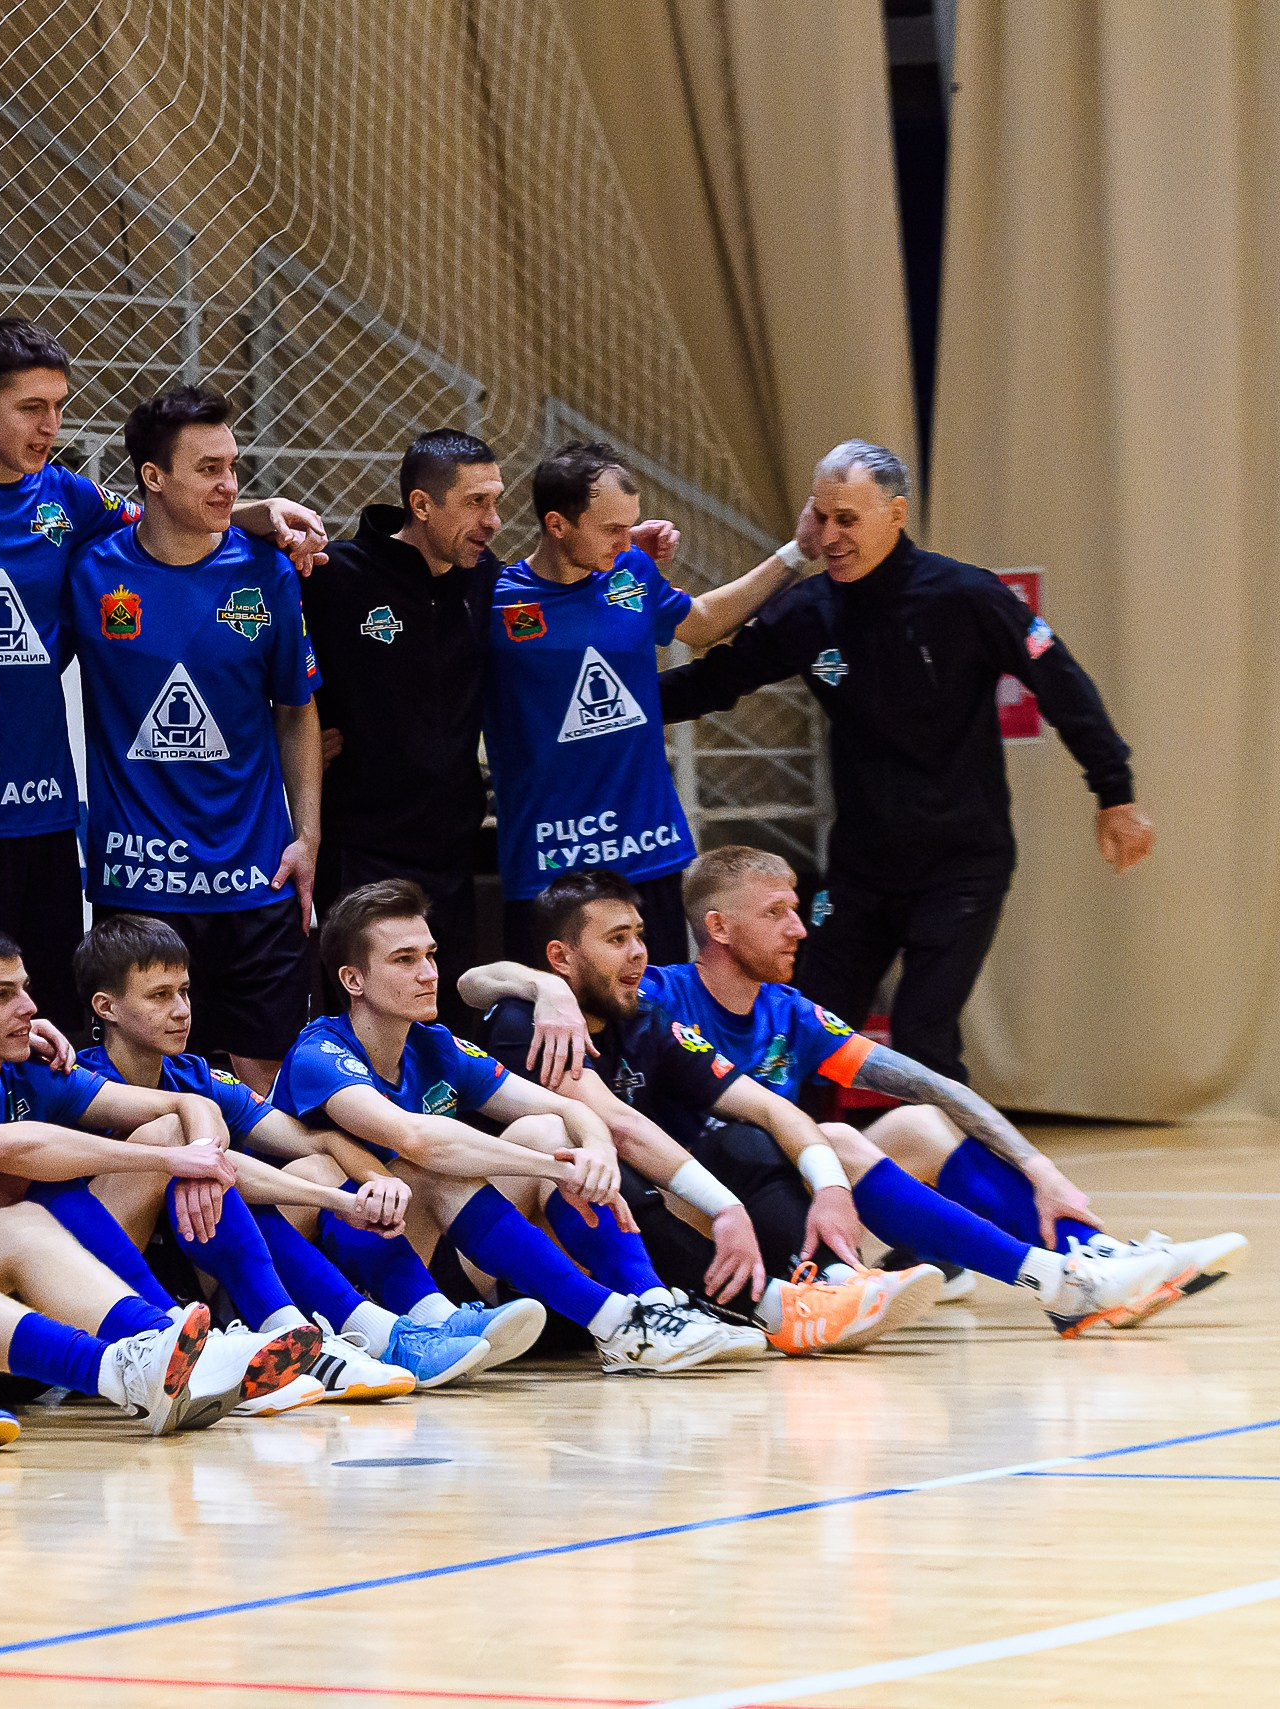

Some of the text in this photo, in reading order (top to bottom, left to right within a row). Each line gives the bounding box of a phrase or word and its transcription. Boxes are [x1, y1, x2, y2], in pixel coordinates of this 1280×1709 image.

[221, 612, 268, 621] КУЗБАСС
[154, 730, 205, 746] АСИ
[135, 749, 223, 759] КОРПОРАЦИЯ
[536, 811, 618, 842] РЦСС
[106, 831, 190, 863] РЦСС
[103, 862, 269, 894] КУЗБАССА
